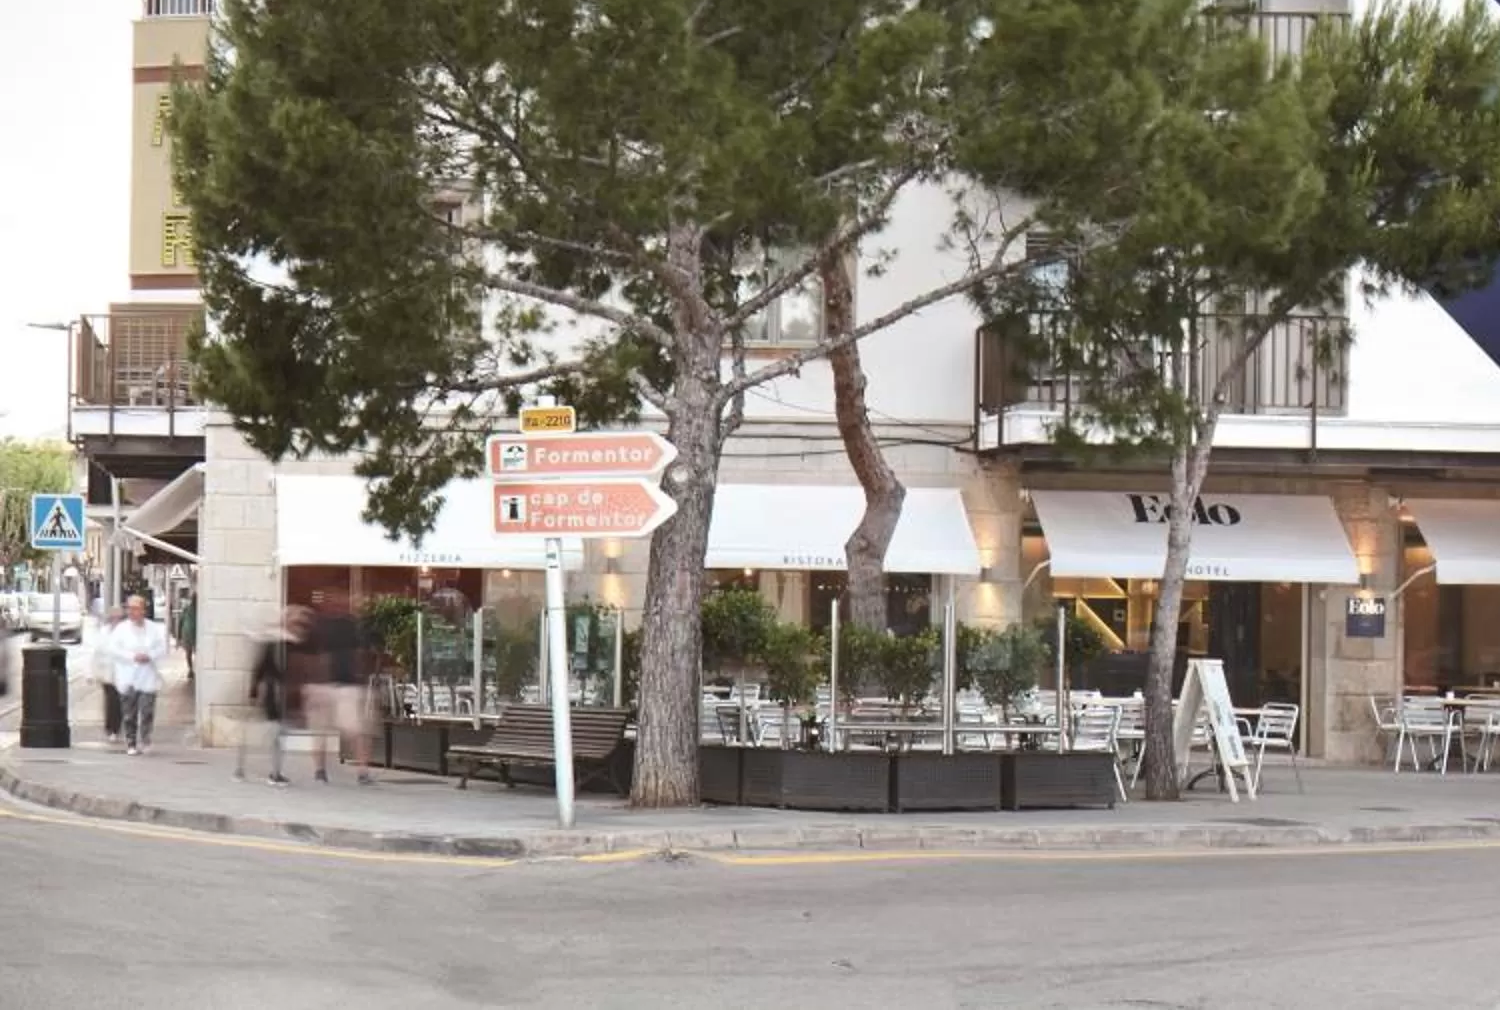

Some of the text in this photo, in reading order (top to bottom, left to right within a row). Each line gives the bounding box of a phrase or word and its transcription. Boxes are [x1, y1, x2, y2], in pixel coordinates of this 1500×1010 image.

[534, 446, 653, 465] Formentor
[577, 489, 603, 505] de
[531, 510, 647, 527] Formentor
[1349, 598, 1385, 615] Eolo
